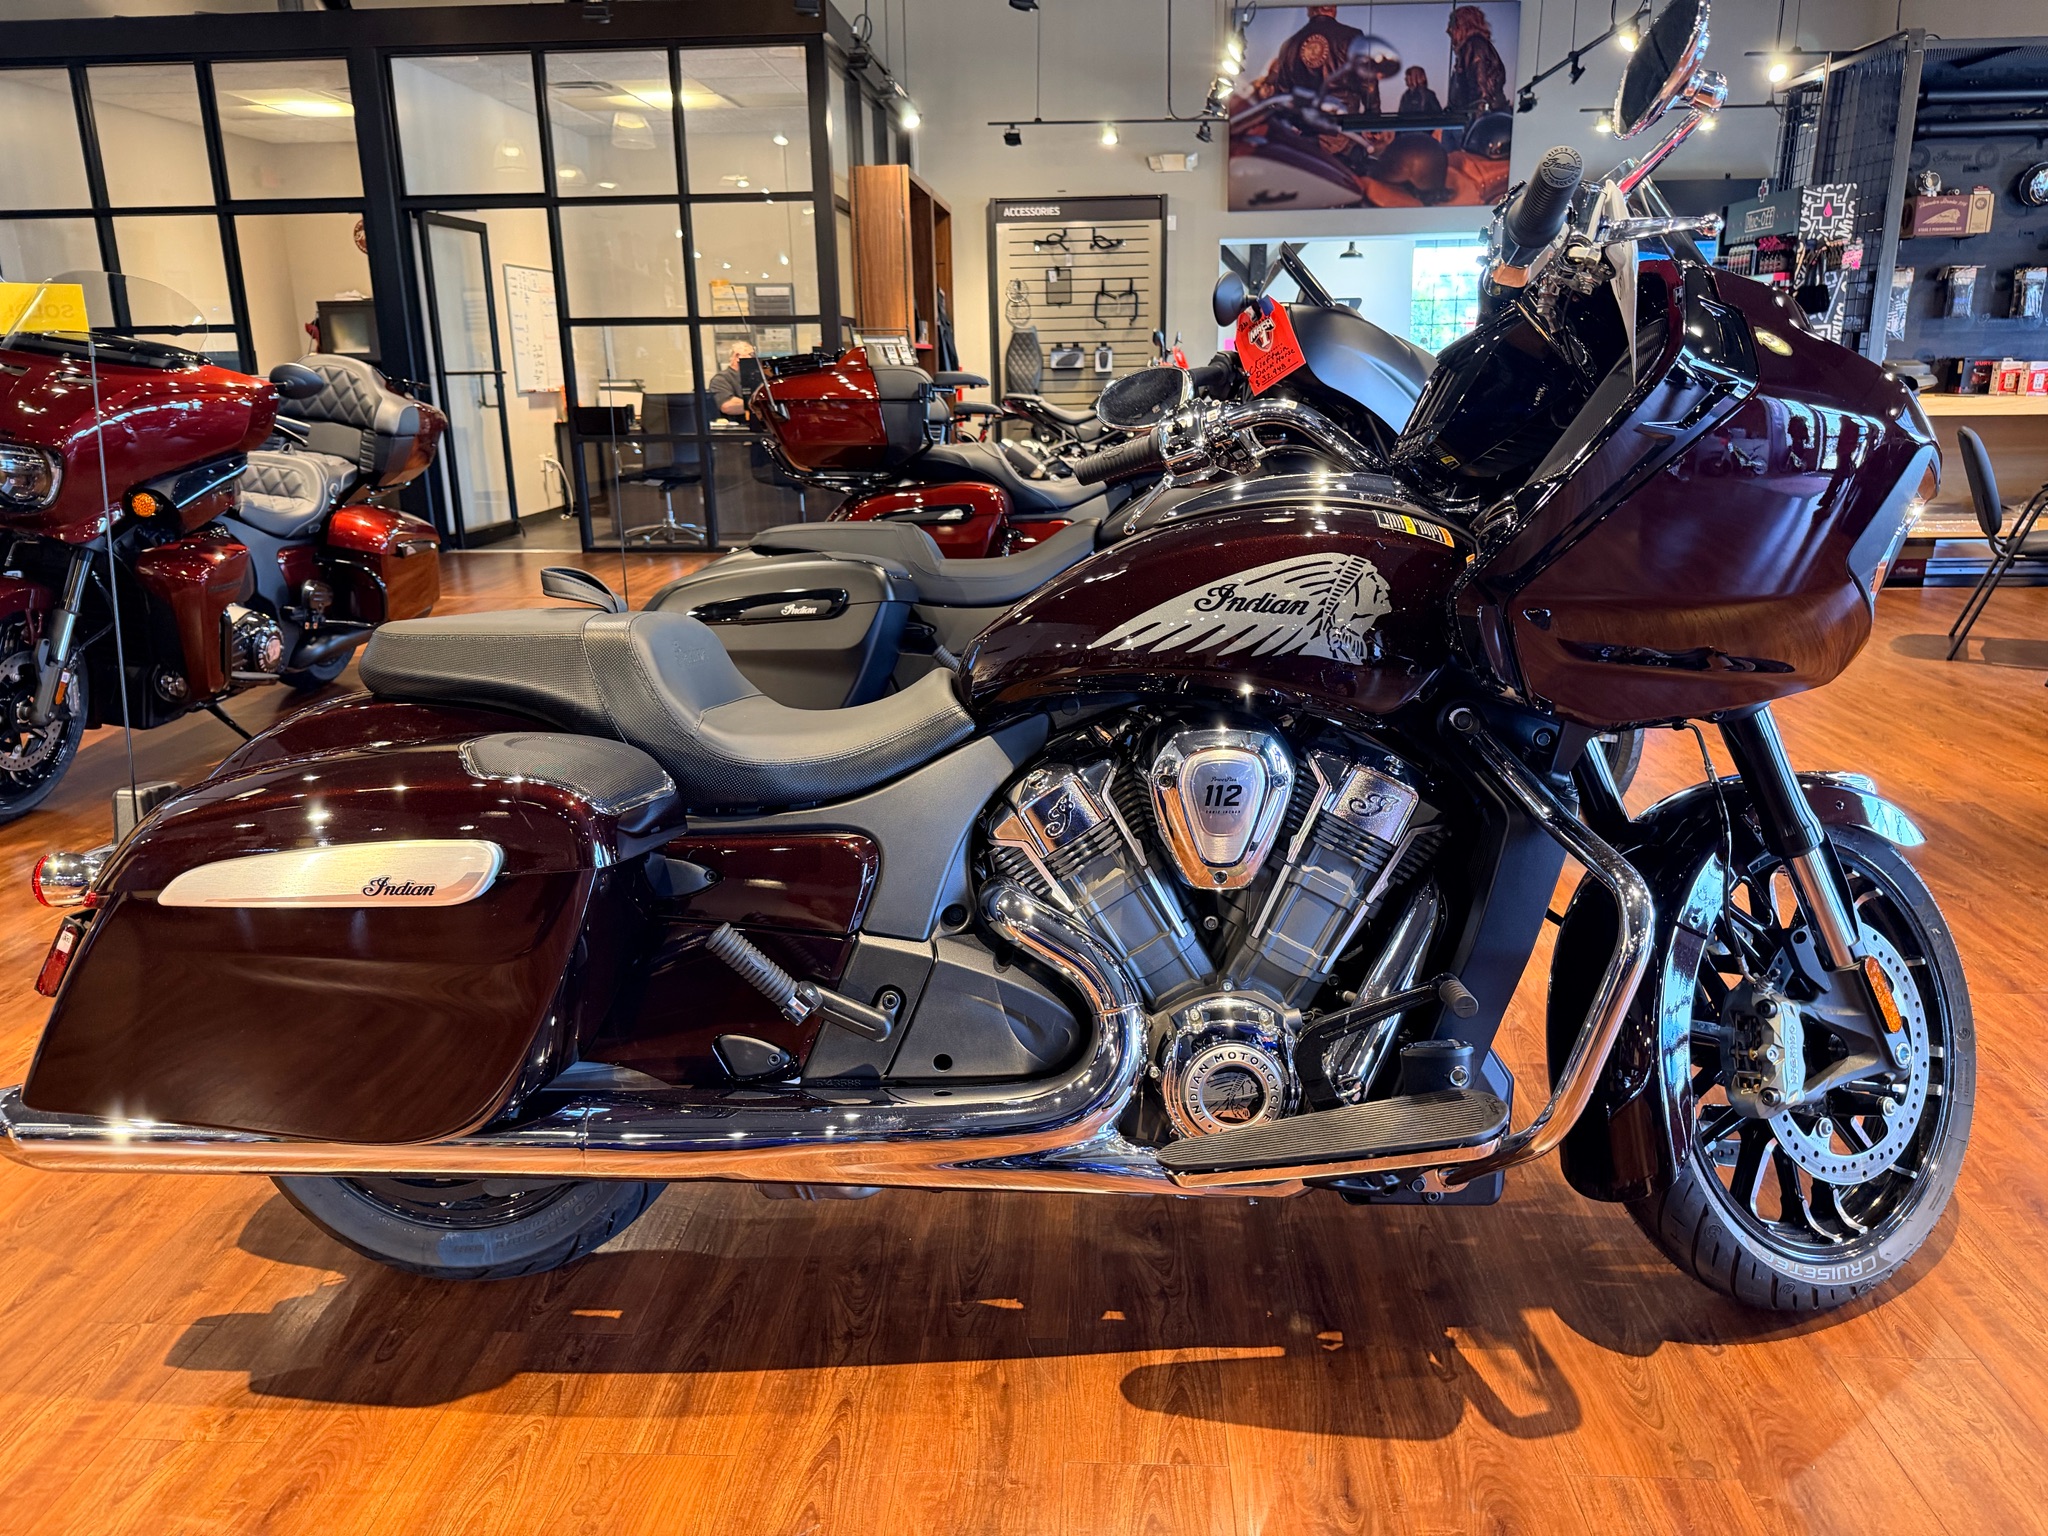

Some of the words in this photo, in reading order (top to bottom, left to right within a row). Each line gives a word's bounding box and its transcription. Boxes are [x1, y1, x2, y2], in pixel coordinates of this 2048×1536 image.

[1542, 157, 1582, 172] Indian
[1003, 206, 1061, 217] ACCESSORIES
[1249, 317, 1275, 344] MACH
[1261, 330, 1270, 348] 1
[781, 603, 817, 616] Indian
[1194, 583, 1310, 615] Indian
[1204, 784, 1243, 807] 112
[362, 876, 436, 897] Indian
[1789, 1024, 1798, 1084] brembo
[1189, 1063, 1209, 1122] INDIAN
[1213, 1051, 1280, 1123] MOTORCYCLE
[1760, 1247, 1878, 1280] CRUISETEC
